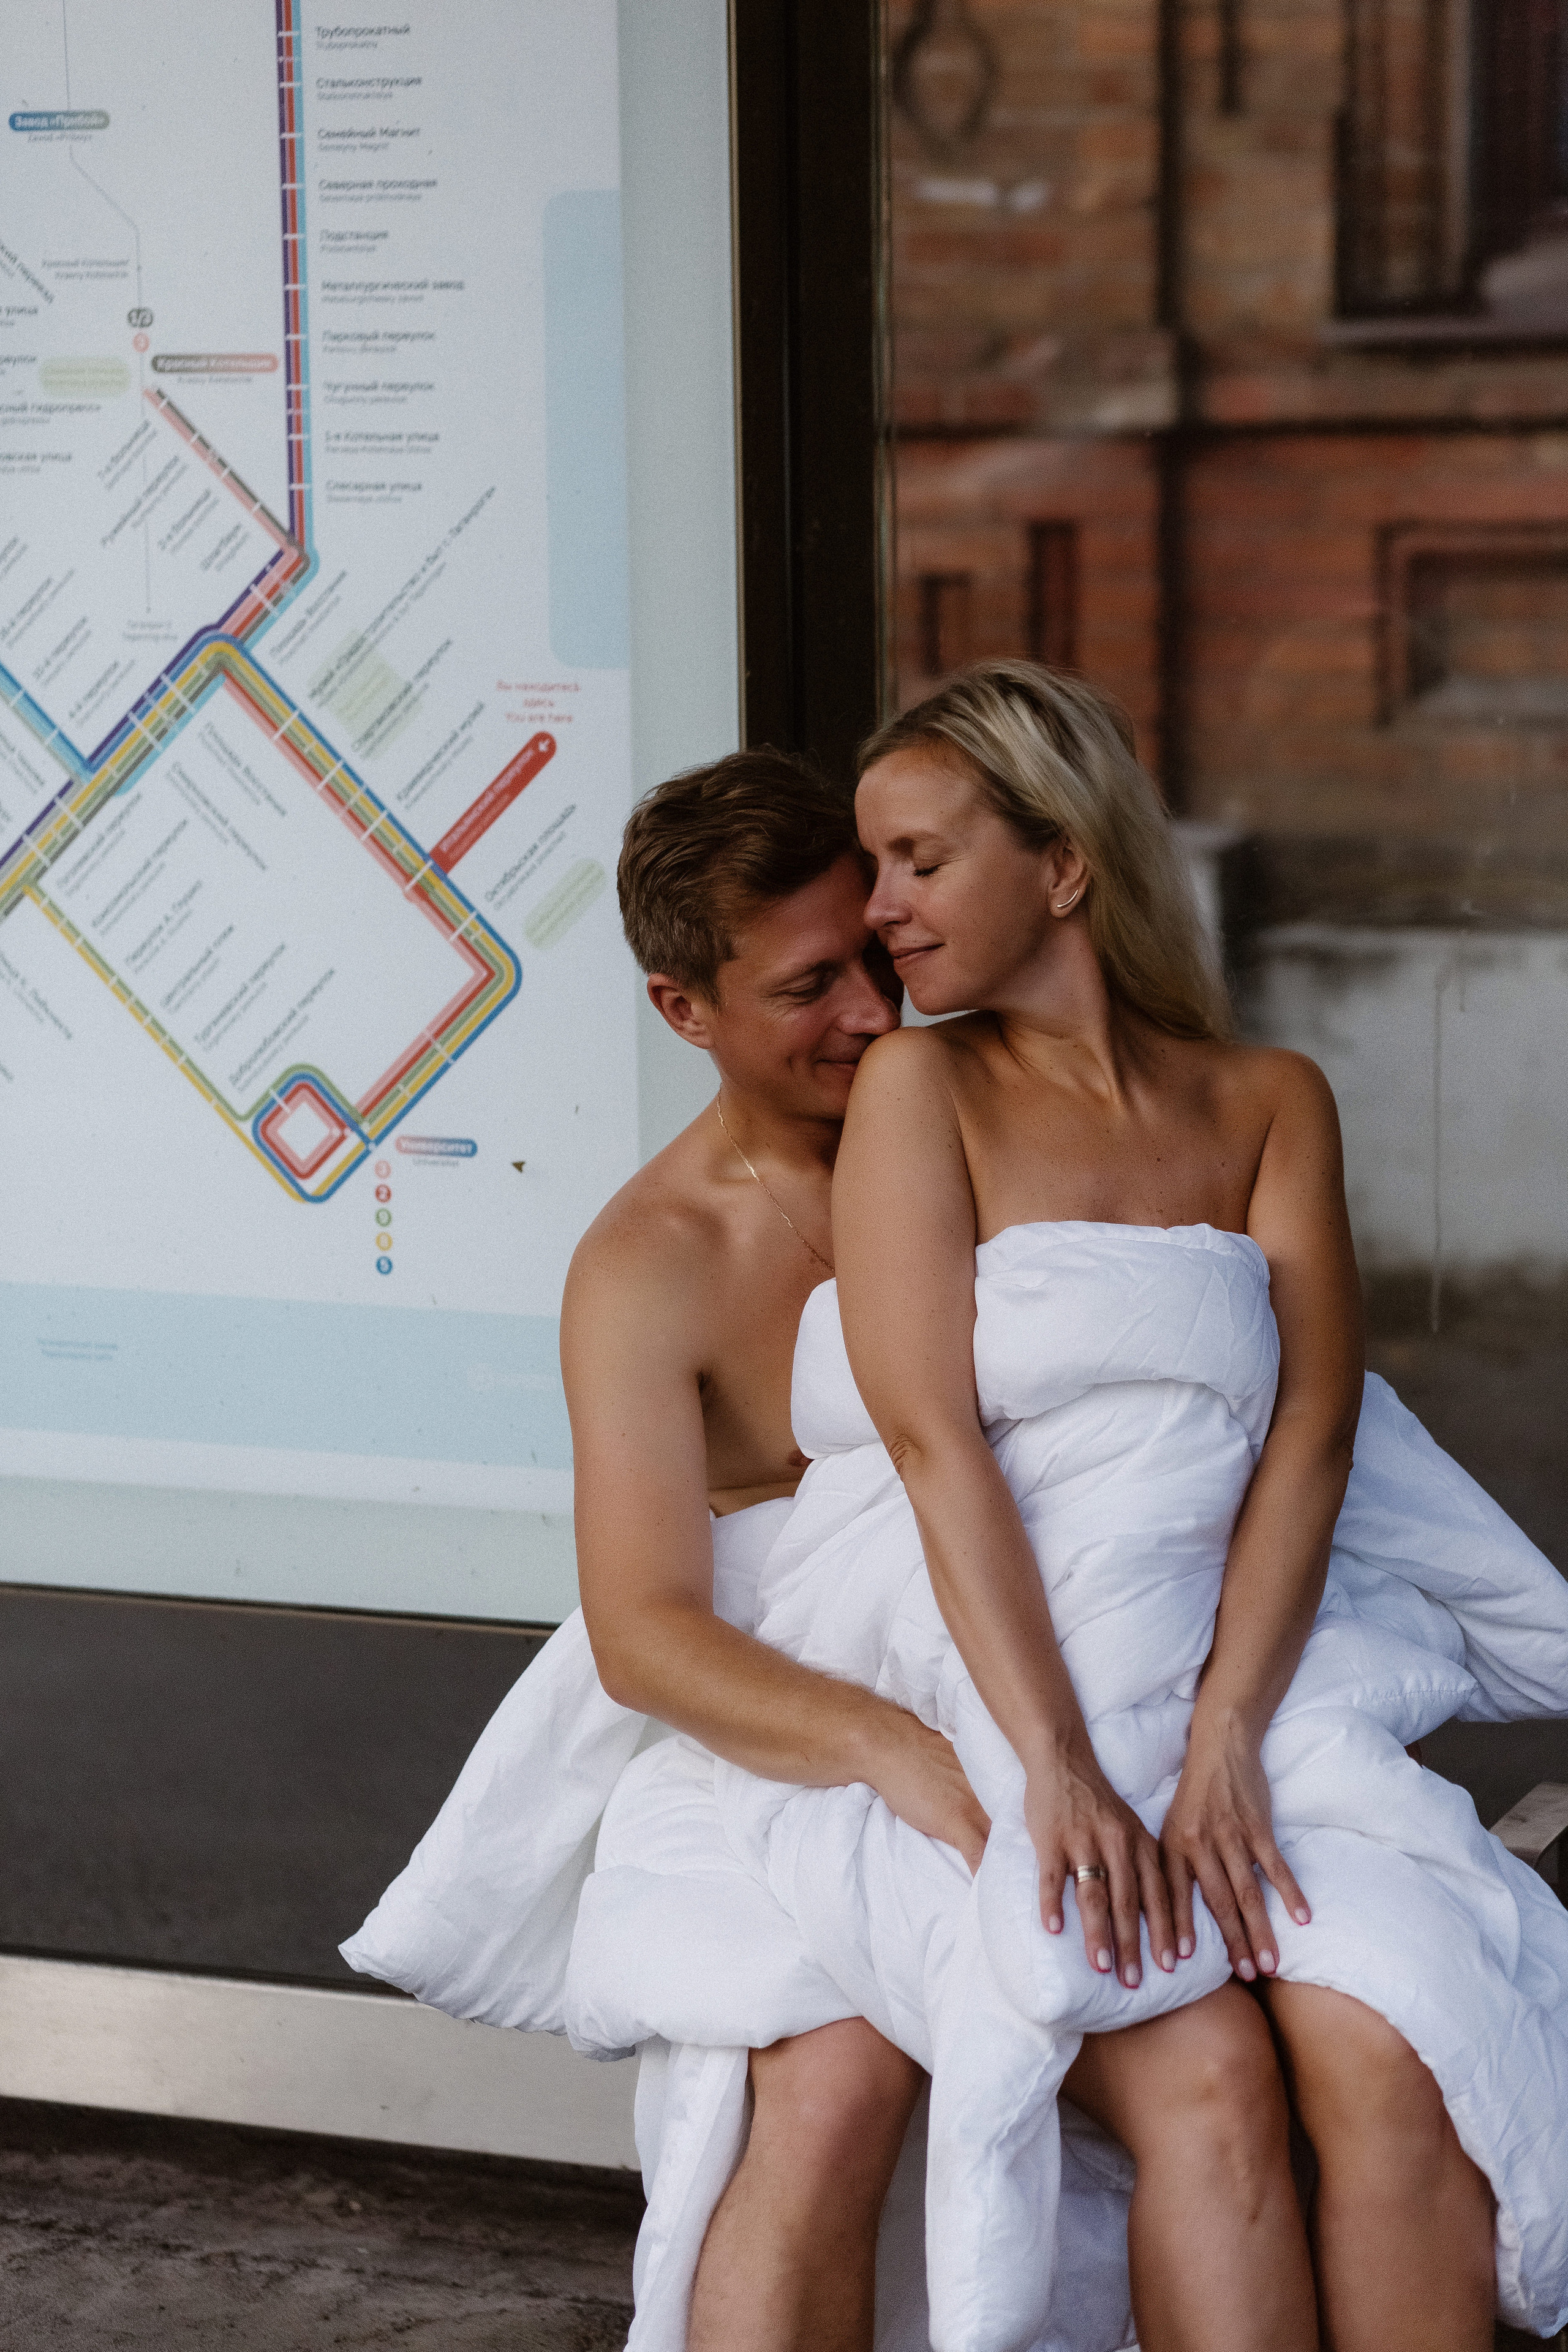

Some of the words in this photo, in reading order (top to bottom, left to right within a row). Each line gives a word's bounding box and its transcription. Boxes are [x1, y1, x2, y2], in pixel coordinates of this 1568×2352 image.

[315, 24, 411, 38] Трубопрокатный
[317, 127, 375, 140] Семейный
[379, 127, 420, 138] Магнит
[318, 179, 374, 191] Северная
[322, 279, 429, 292] Металлургический
